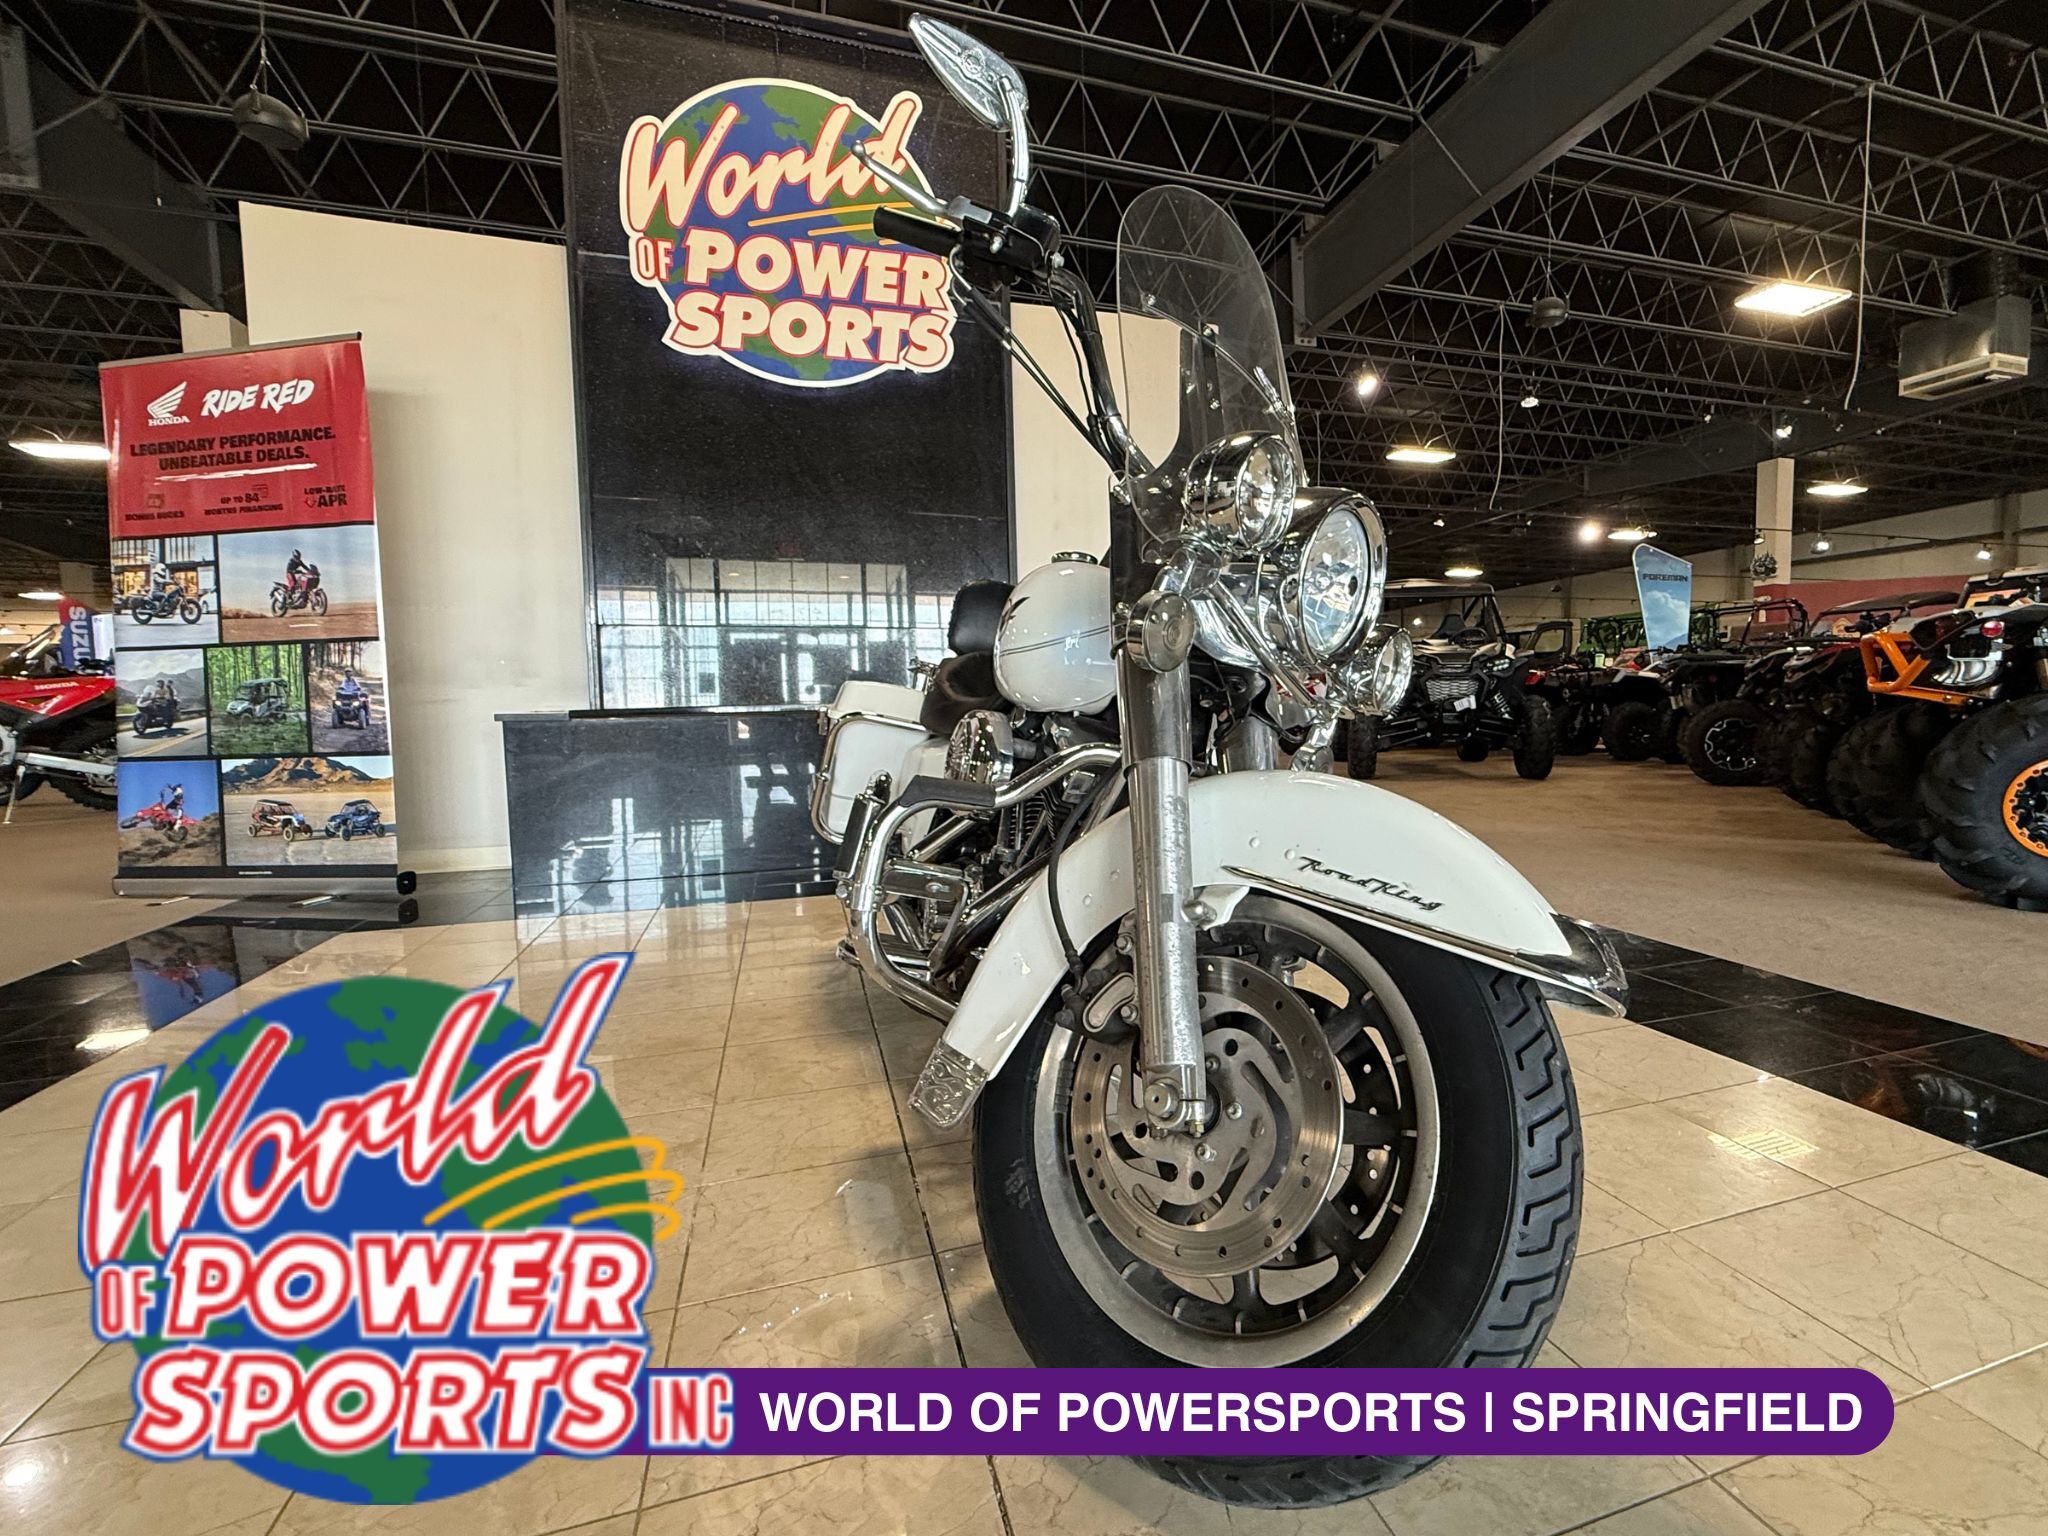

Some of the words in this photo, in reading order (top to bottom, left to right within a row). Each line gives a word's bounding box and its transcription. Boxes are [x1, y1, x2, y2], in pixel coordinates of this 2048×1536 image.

[627, 97, 917, 232] World
[634, 237, 675, 281] OF
[683, 226, 948, 311] POWER
[669, 289, 949, 368] SPORTS
[200, 385, 259, 418] RIDE
[260, 378, 315, 414] RED
[148, 416, 190, 426] HONDA
[130, 437, 215, 457] LEGENDARY
[219, 426, 336, 449] PERFORMANCE.
[159, 451, 253, 471] UNBEATABLE
[256, 446, 310, 462] DEALS.
[317, 493, 348, 508] APR
[1643, 574, 1689, 582] FOREMAN
[34, 682, 79, 691] HONDA
